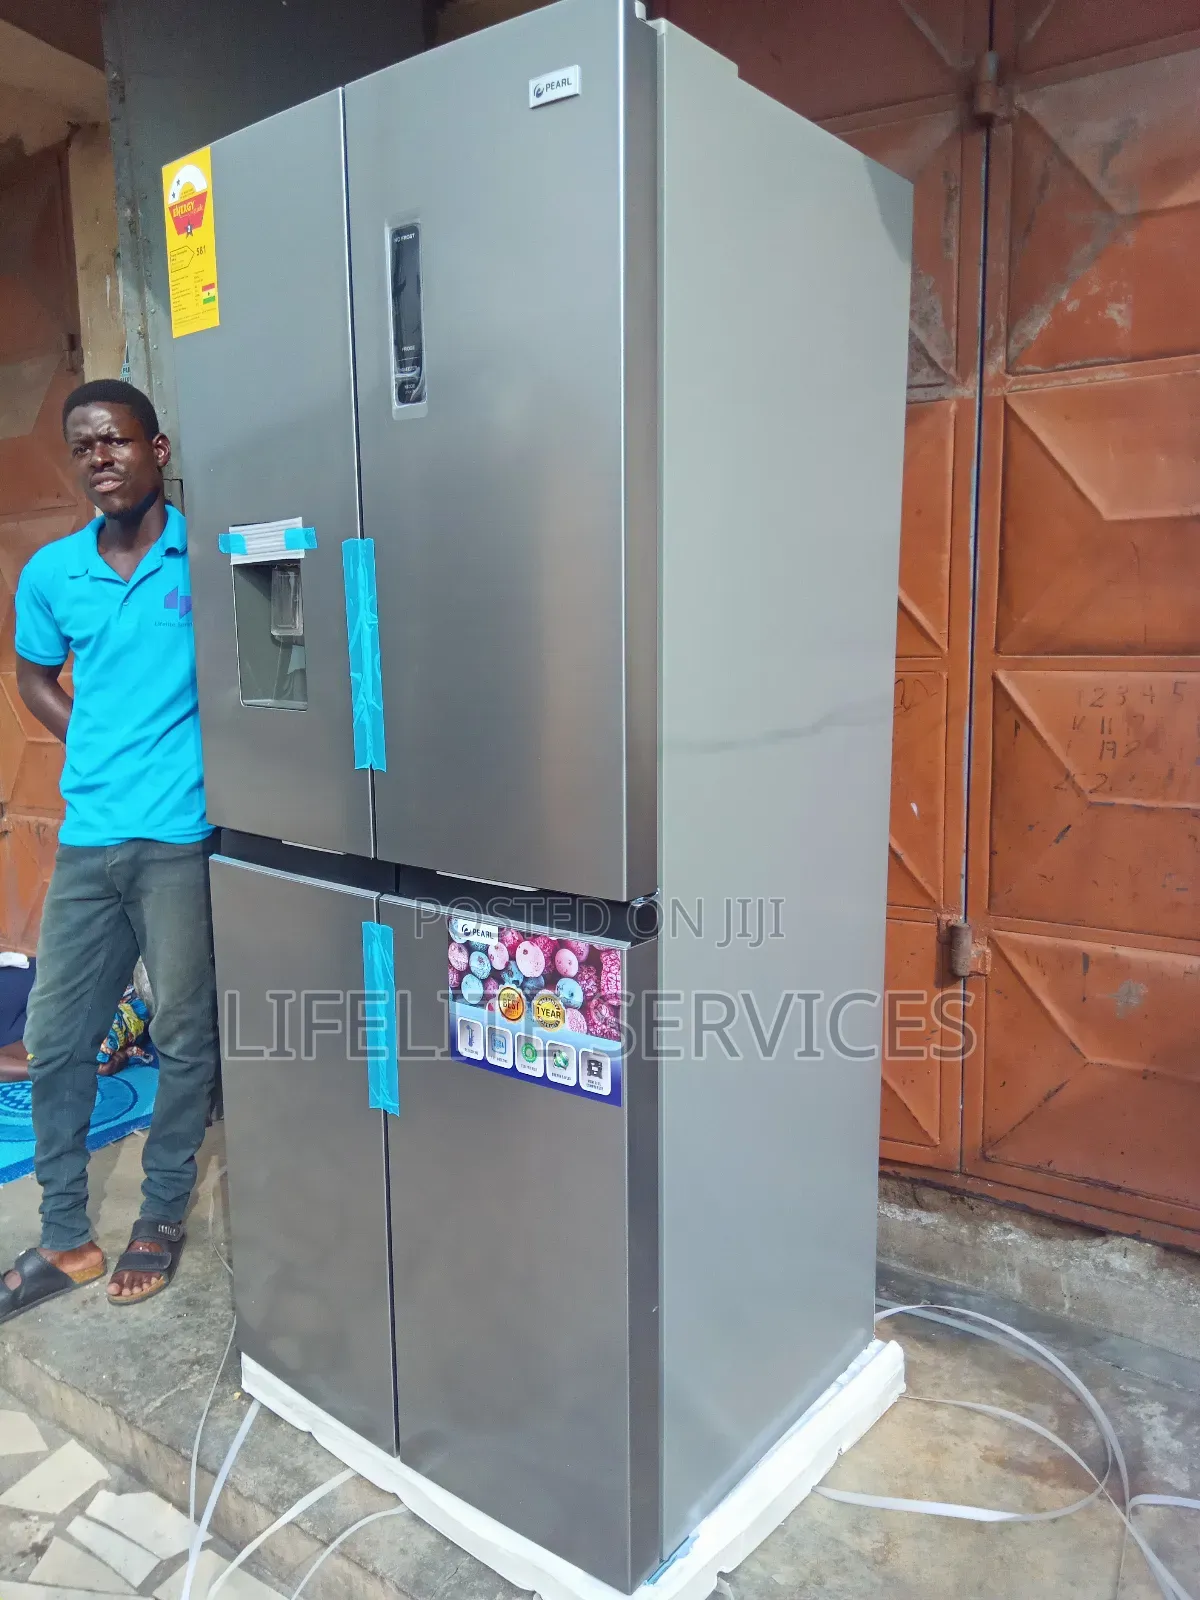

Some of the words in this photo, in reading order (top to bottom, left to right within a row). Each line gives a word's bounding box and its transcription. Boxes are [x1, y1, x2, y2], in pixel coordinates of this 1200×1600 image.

[546, 78, 572, 92] PEARL
[173, 200, 195, 217] ENERGY
[472, 928, 494, 940] PEARL
[502, 998, 520, 1011] BEST
[535, 1006, 540, 1015] 1
[540, 1007, 561, 1019] YEAR
